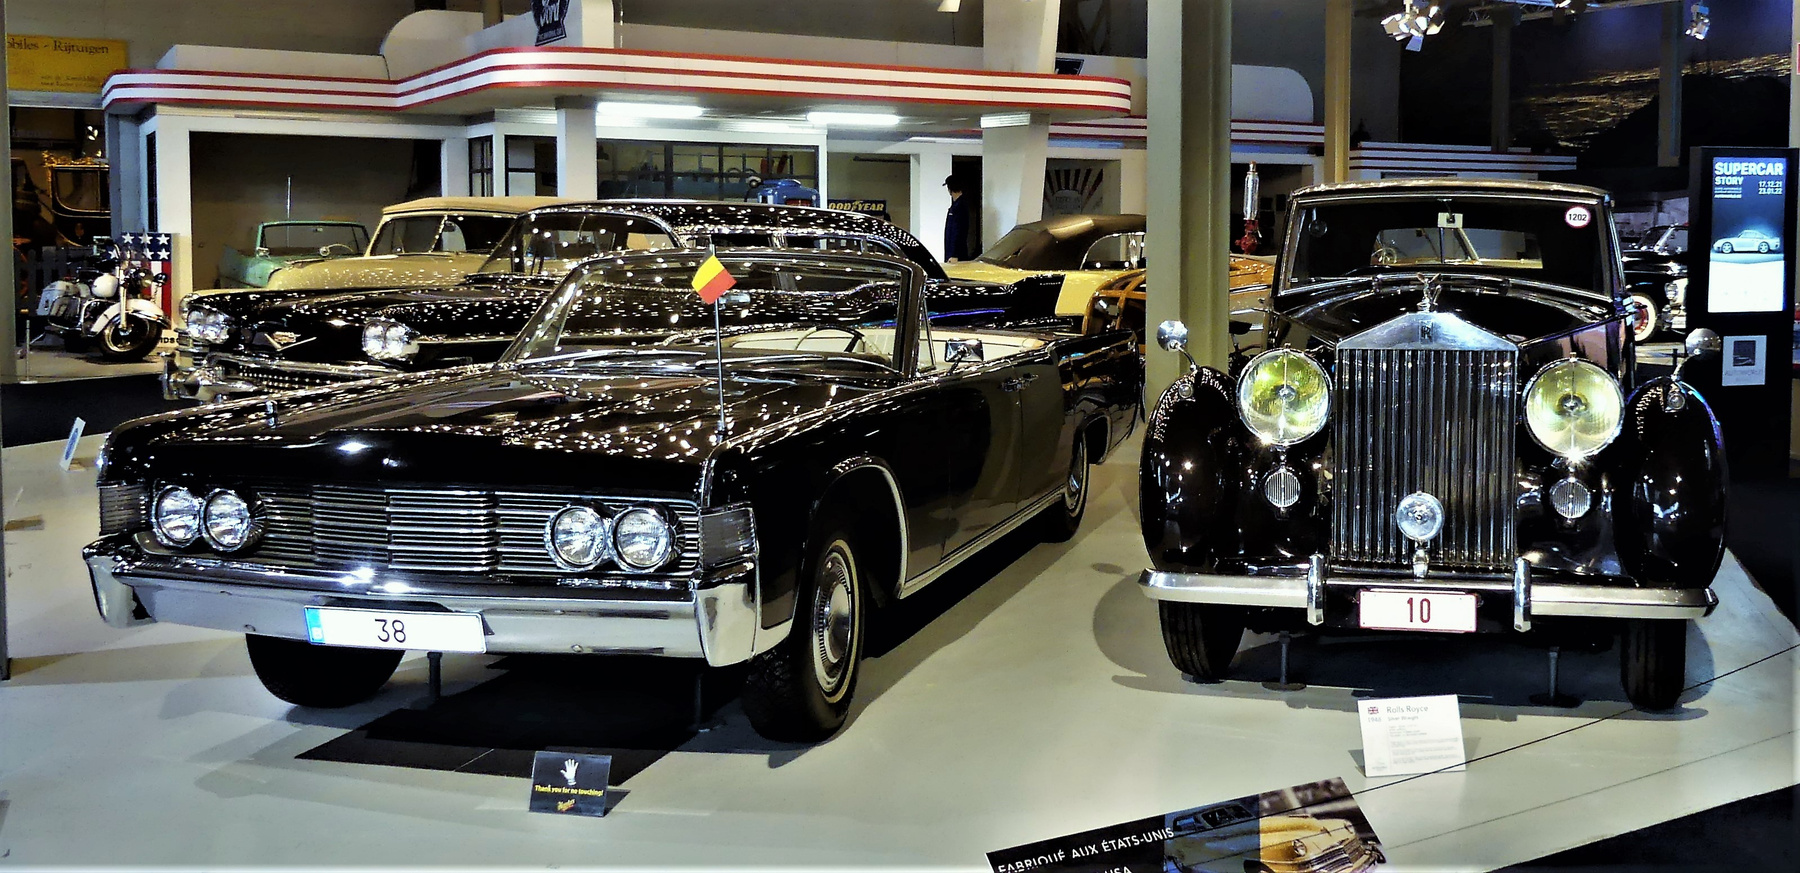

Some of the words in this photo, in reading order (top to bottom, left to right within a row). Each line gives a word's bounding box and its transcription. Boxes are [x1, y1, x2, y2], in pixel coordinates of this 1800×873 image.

[7, 38, 39, 50] obiles
[1714, 162, 1784, 176] SUPERCAR
[1714, 176, 1744, 185] STORY
[1758, 180, 1783, 188] 17.12.21
[828, 202, 885, 211] OODYEAR
[1568, 213, 1588, 221] 1202
[1407, 597, 1431, 623] 10
[374, 618, 407, 643] 38
[1386, 706, 1405, 714] Rolls
[1405, 705, 1428, 714] Royce
[535, 785, 551, 793] Thank
[1072, 844, 1099, 859] AUX
[1101, 827, 1175, 852] ÉTATS-UNIS
